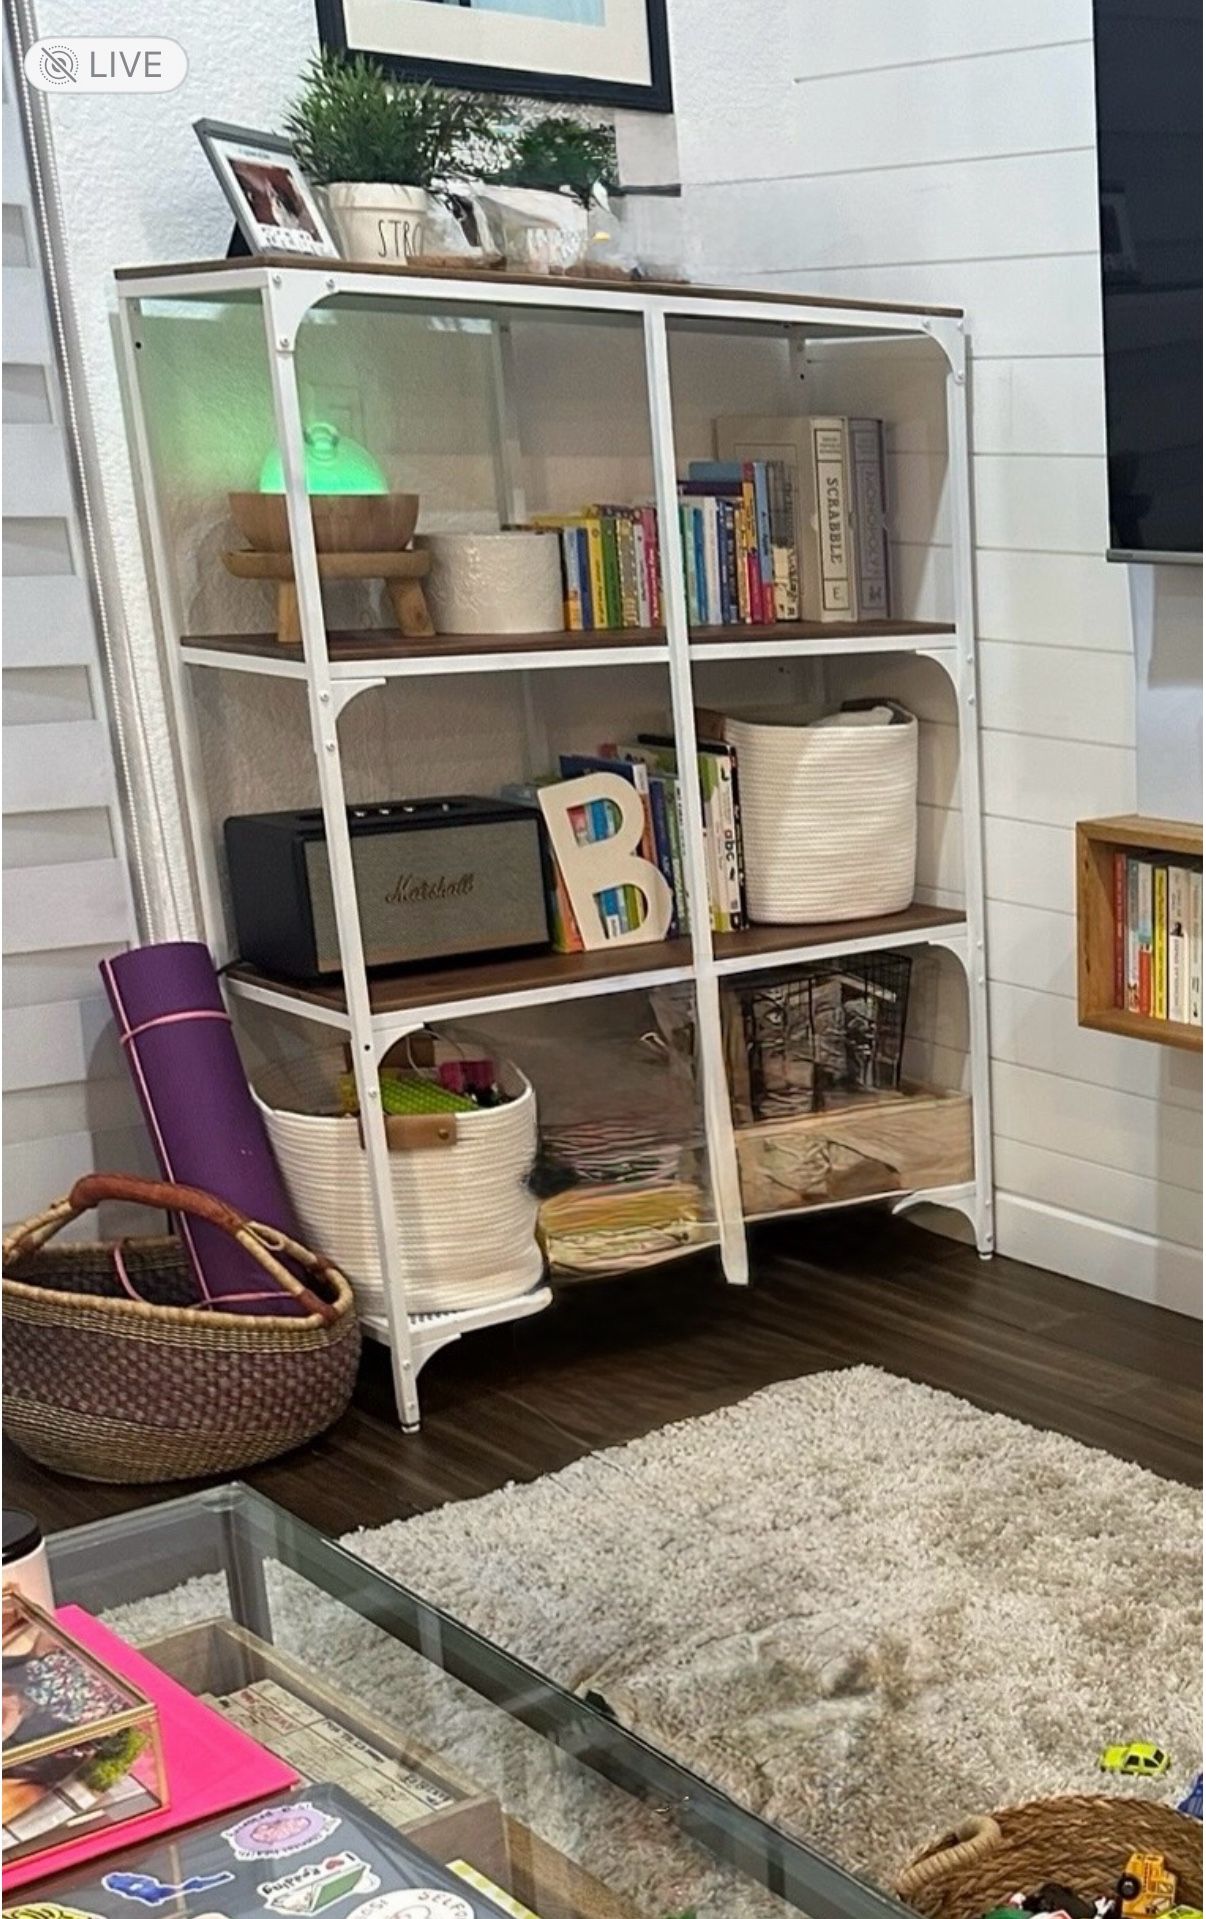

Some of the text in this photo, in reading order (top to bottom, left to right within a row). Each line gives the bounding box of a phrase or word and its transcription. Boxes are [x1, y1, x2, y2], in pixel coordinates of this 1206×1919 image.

[826, 476, 843, 565] SCRABBLE
[537, 772, 673, 951] B
[724, 829, 735, 862] abc
[385, 873, 474, 904] Marshall
[262, 1866, 322, 1896] Reading
